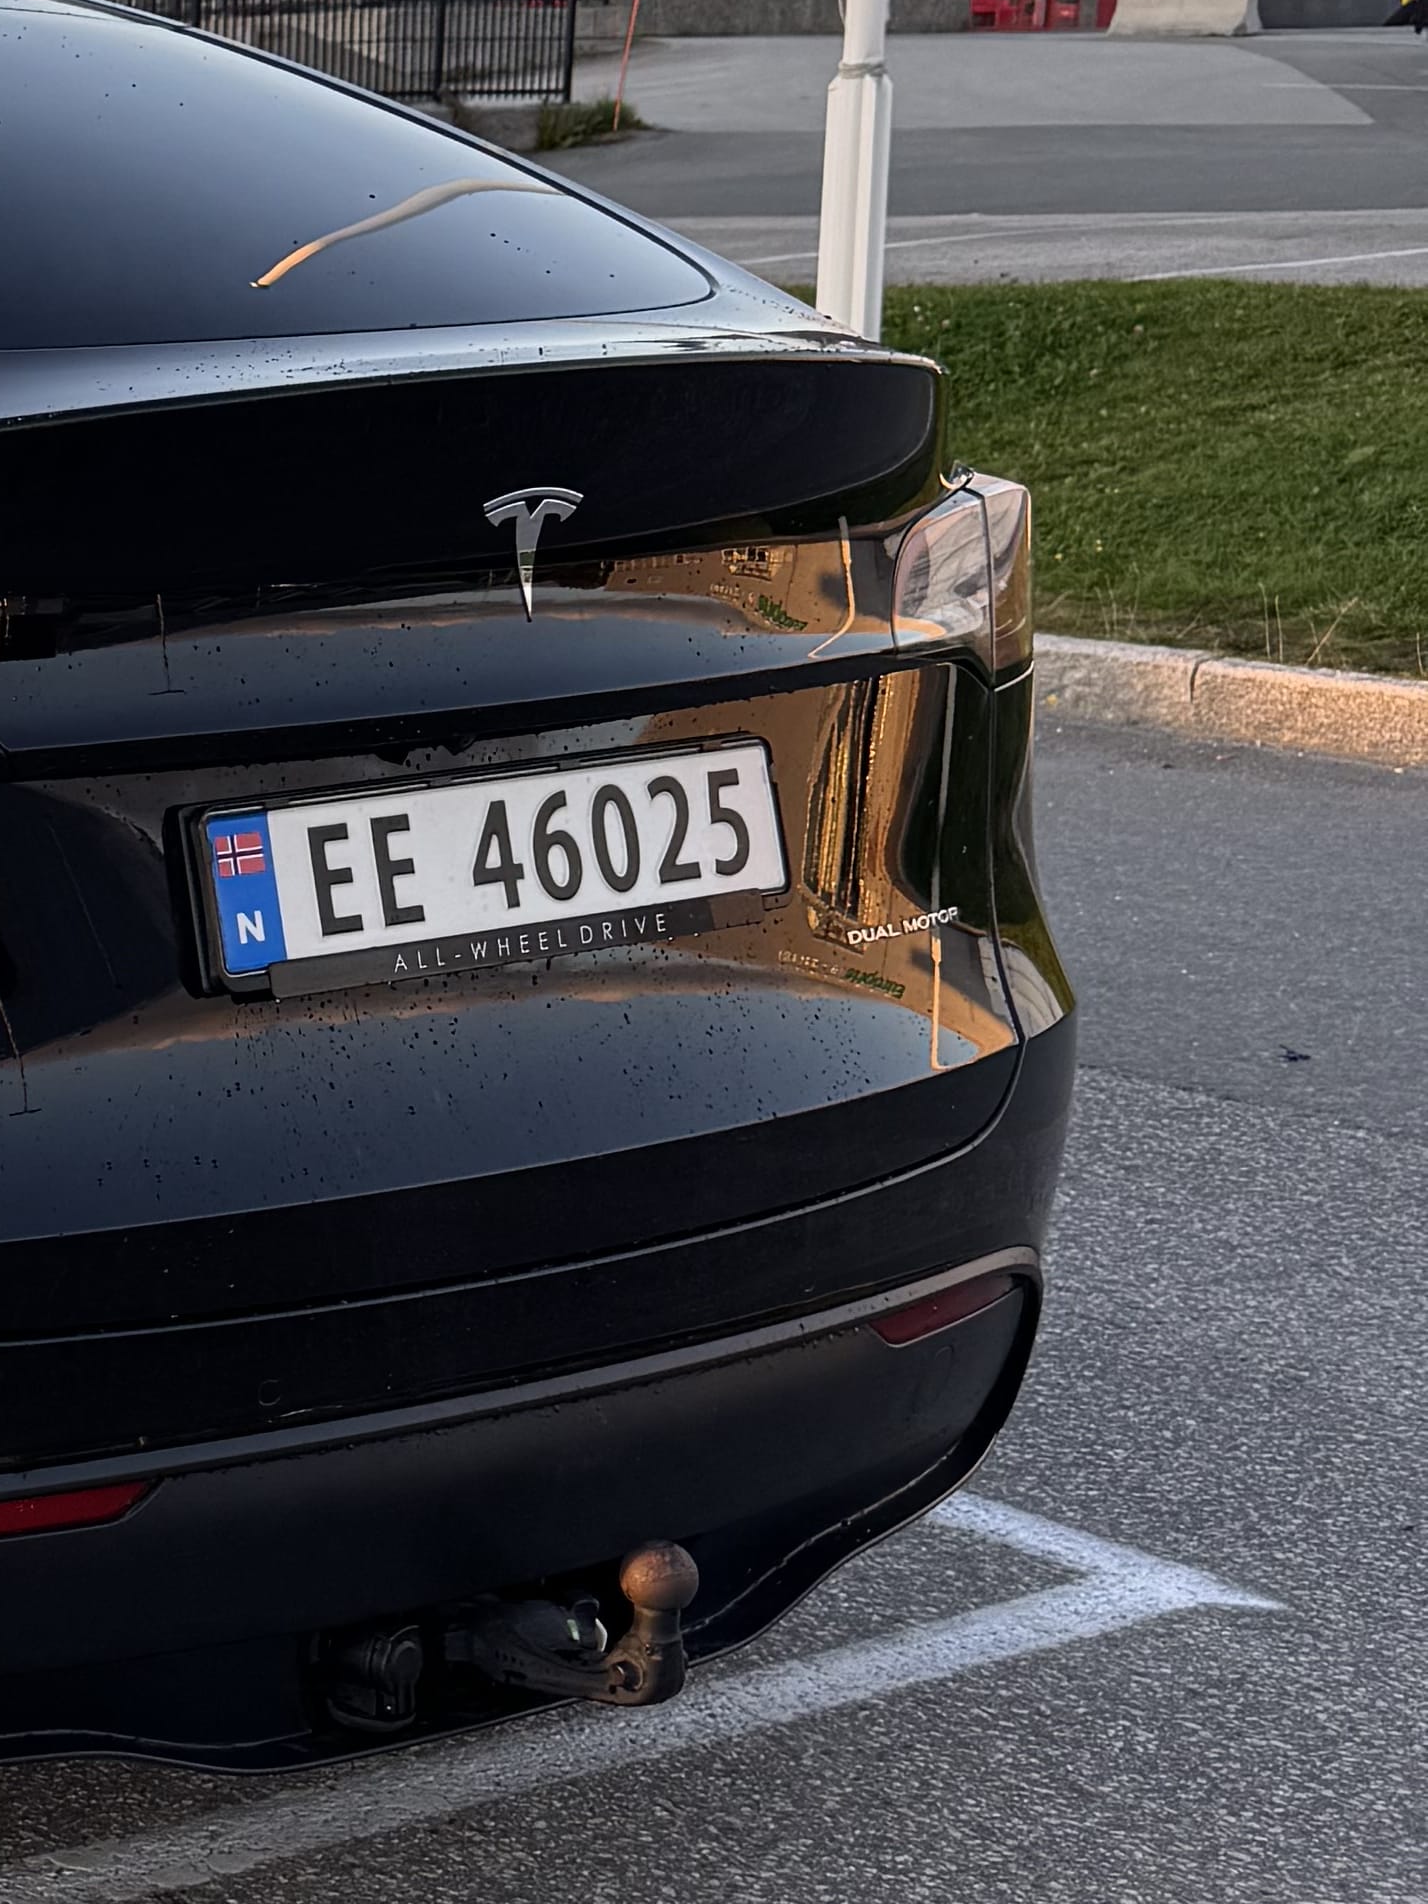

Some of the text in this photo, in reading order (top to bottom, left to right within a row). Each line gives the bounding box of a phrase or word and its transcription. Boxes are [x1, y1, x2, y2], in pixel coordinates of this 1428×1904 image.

[306, 767, 751, 938] EE 46025
[237, 910, 266, 945] N
[579, 913, 668, 945] DRIVE
[846, 906, 959, 945] DUAL MOTOR
